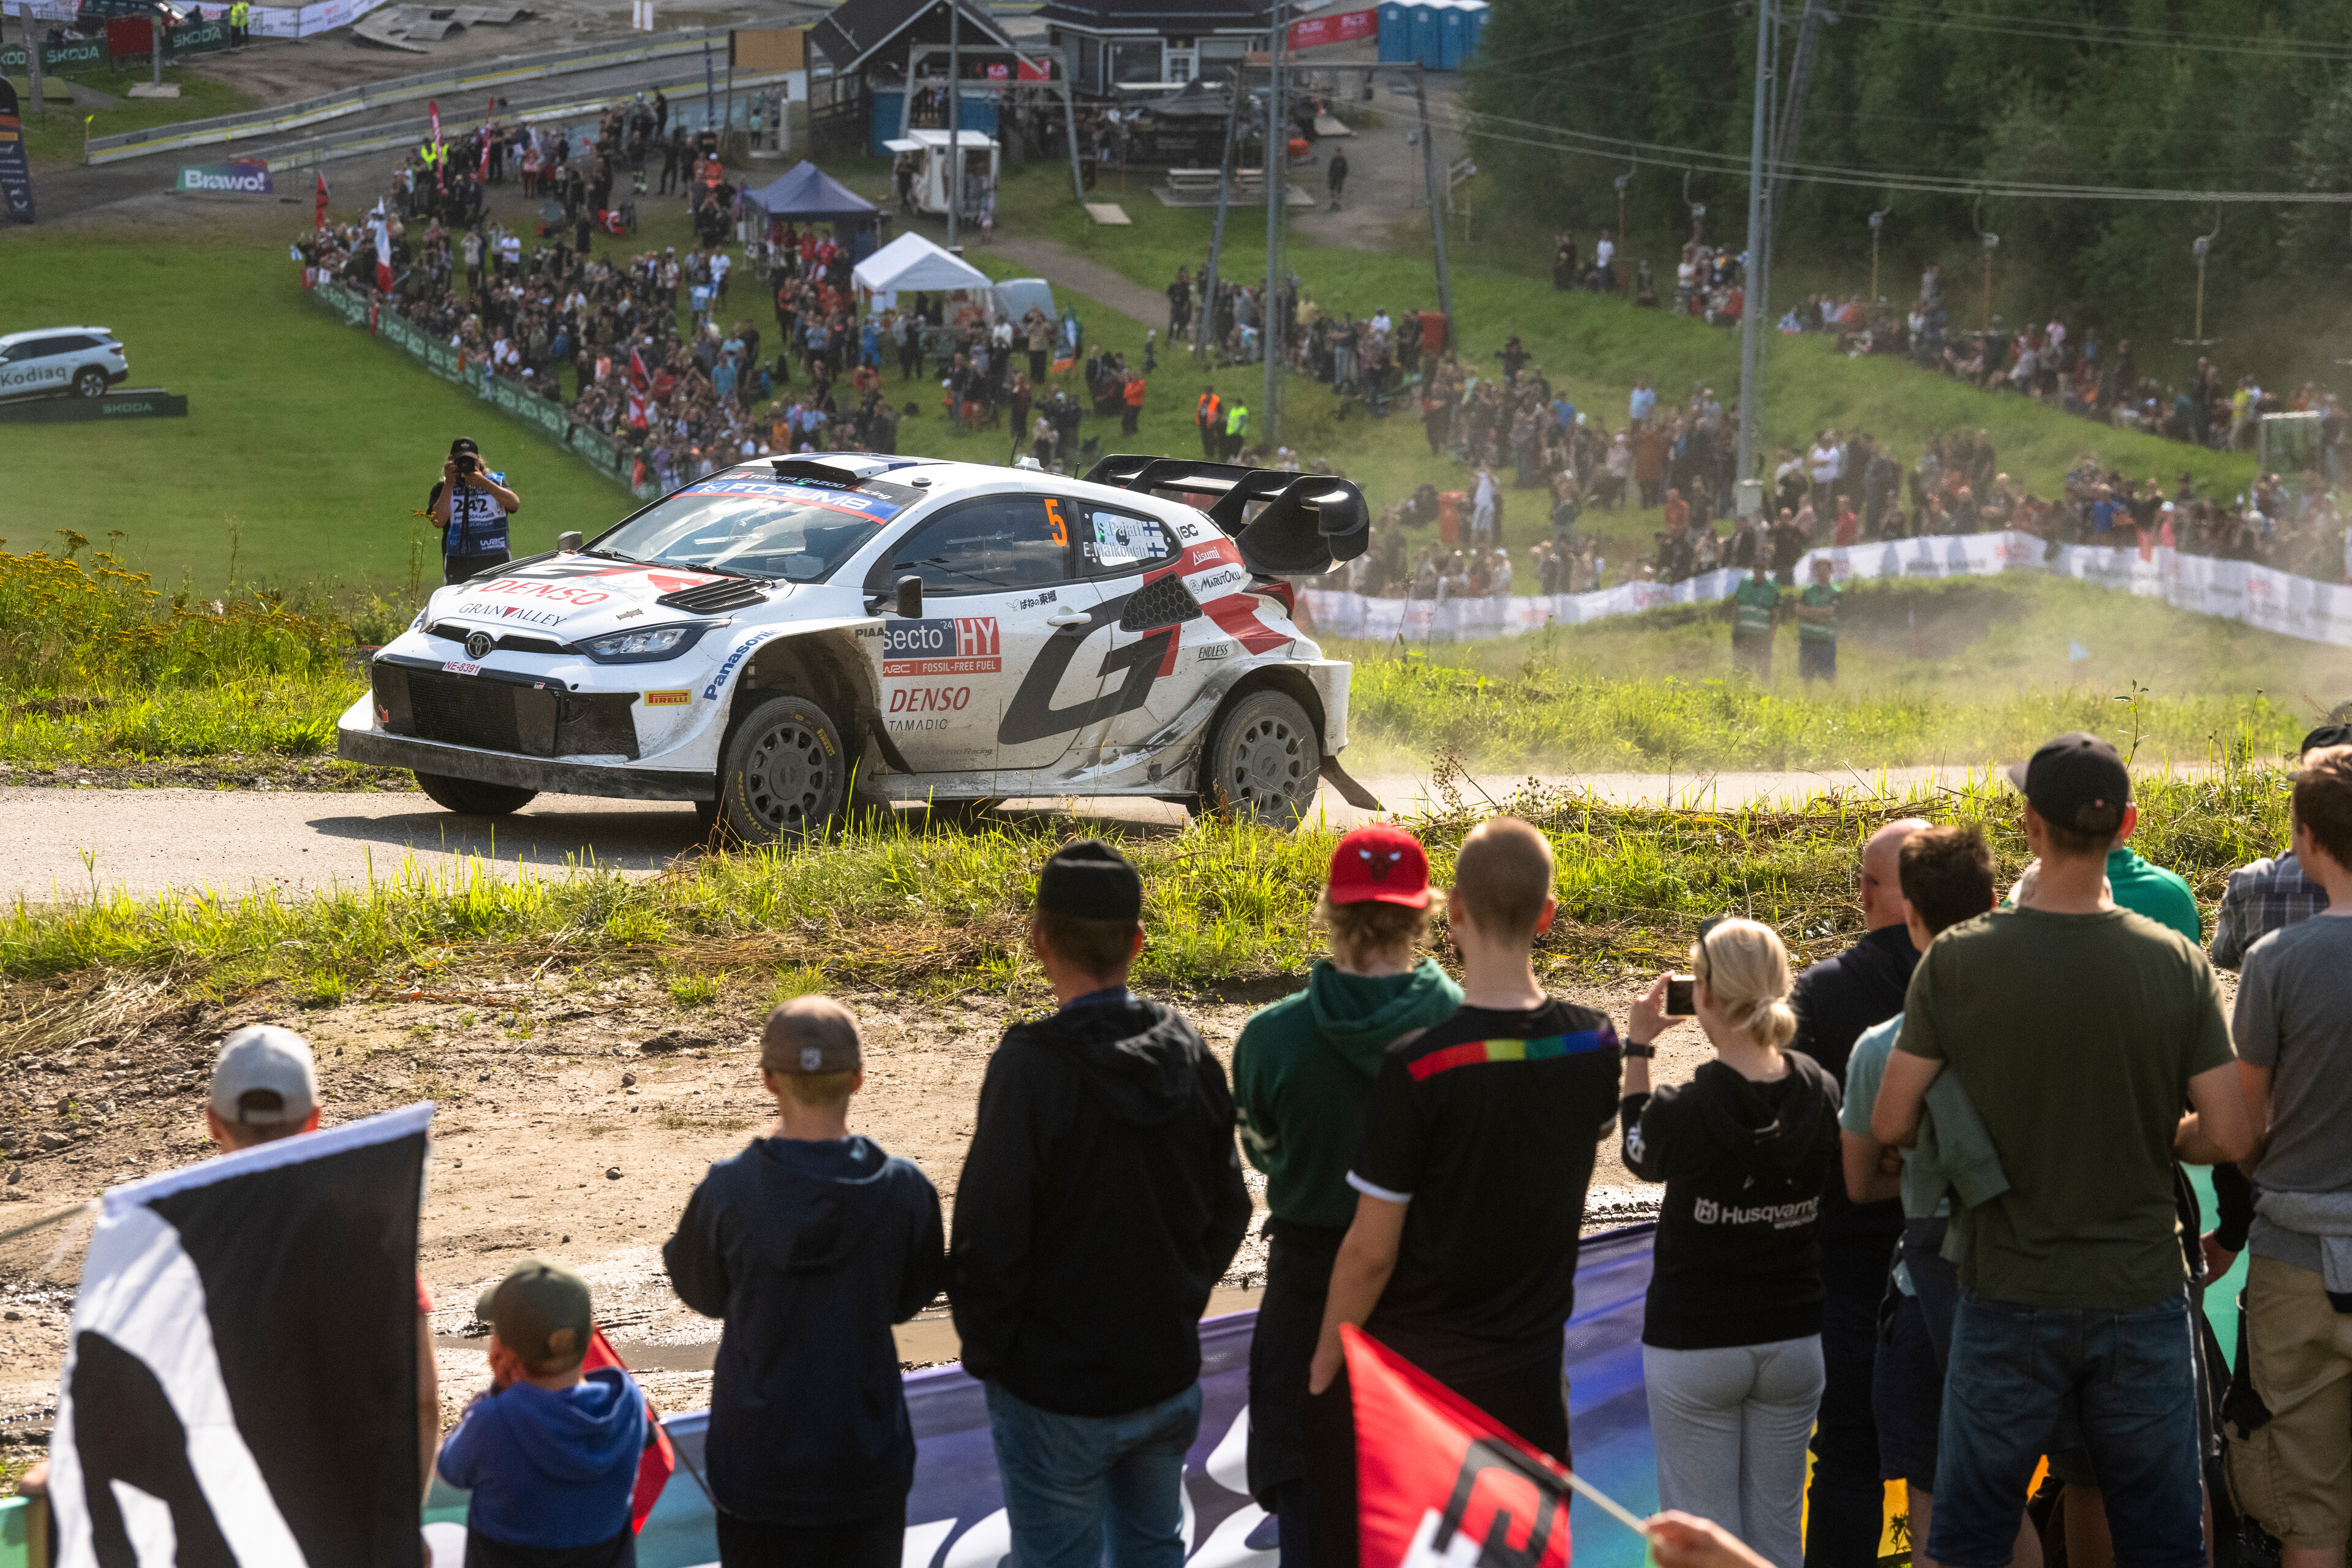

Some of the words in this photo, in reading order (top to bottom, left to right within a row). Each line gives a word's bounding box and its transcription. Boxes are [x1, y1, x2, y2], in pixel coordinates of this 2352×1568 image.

[185, 169, 265, 191] Brawo!
[0, 366, 67, 387] Kodiaq
[799, 478, 846, 489] GAZOO
[846, 485, 893, 500] Racing
[1044, 499, 1068, 546] 5
[1193, 546, 1221, 566] Aisumi
[479, 579, 610, 605] DENSO
[1020, 590, 1057, 610] ばねの東郷
[855, 627, 884, 638] PIAA
[884, 625, 943, 650] secto
[940, 620, 953, 629] '24
[957, 618, 995, 655] HY
[1198, 644, 1228, 658] ENDLESS
[444, 661, 481, 673] NE-8391
[703, 630, 783, 701] Panasonic
[883, 664, 910, 673] WRC
[922, 662, 974, 673] FOSSIL-FREE
[976, 661, 996, 671] FUEL
[649, 692, 688, 703] PIRELLI
[889, 686, 970, 712] DENSO
[889, 718, 948, 731] TAMADIC
